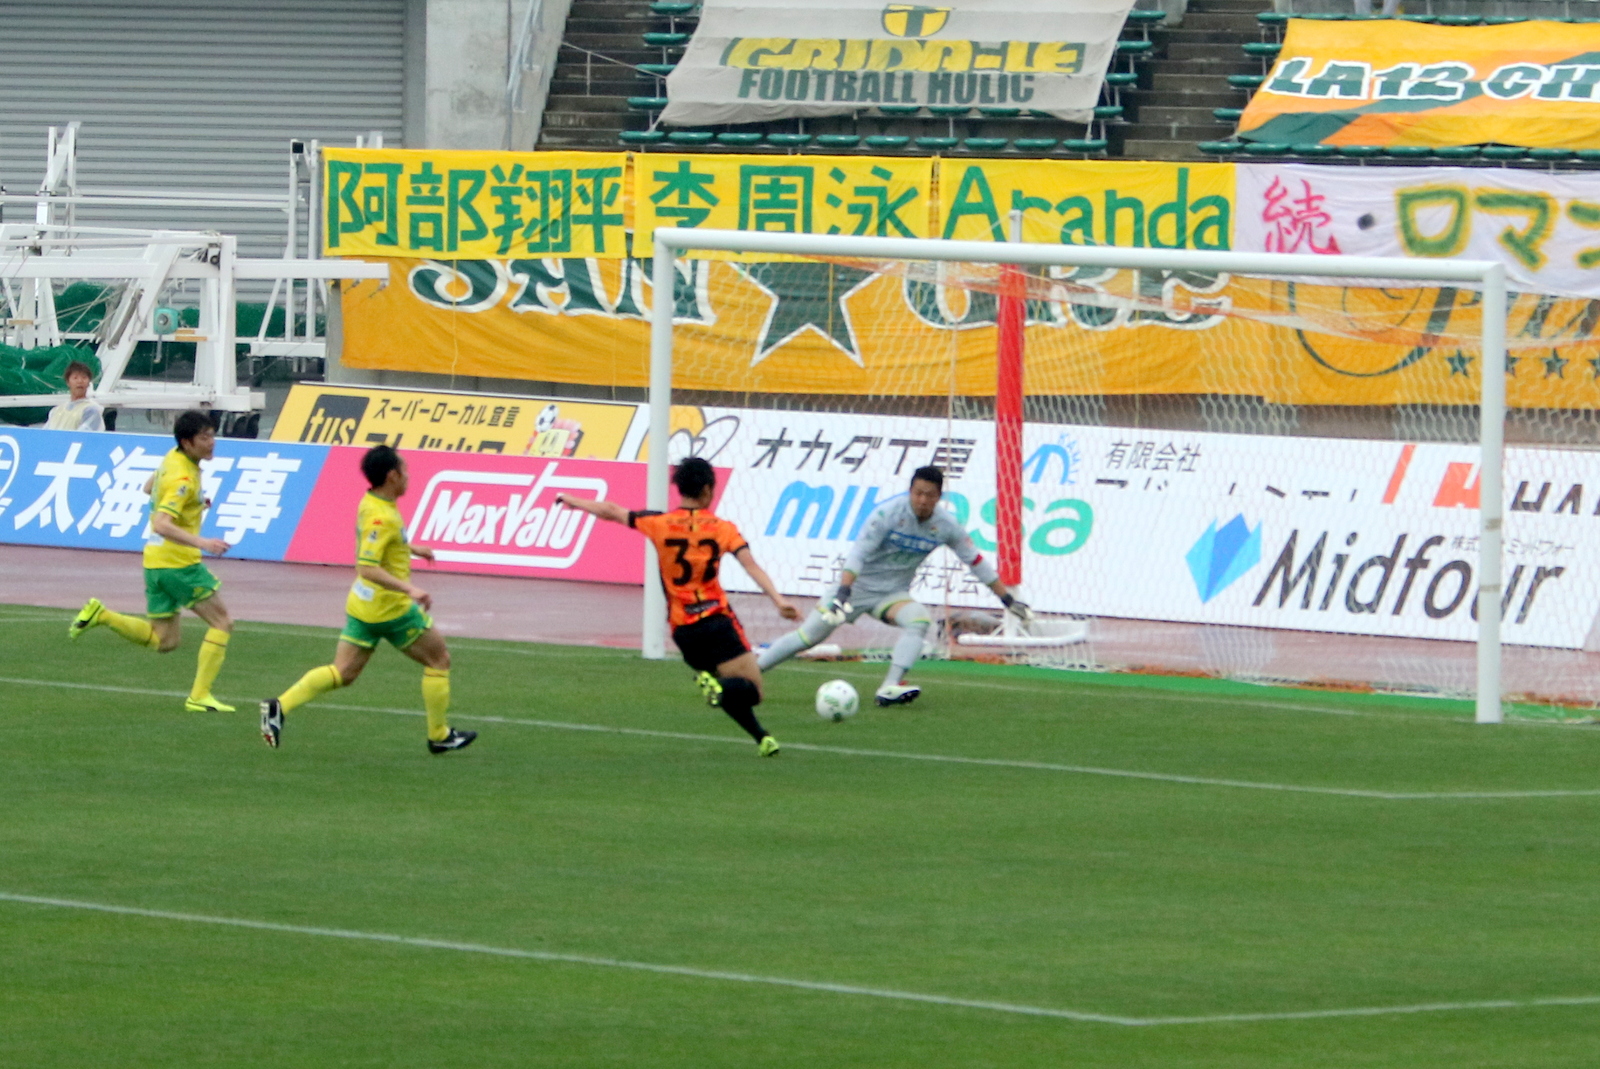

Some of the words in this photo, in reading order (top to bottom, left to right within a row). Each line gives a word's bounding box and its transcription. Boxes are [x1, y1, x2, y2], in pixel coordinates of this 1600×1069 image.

[738, 68, 917, 103] FOOTBALL
[927, 72, 1034, 104] HOLIC
[328, 160, 624, 254] 阿部翔平
[649, 161, 920, 248] 李周泳
[942, 165, 1230, 250] Aranda
[373, 398, 521, 428] スーパーローカル宣言
[1105, 437, 1202, 473] 有限会社
[420, 466, 584, 550] MaxValu
[665, 538, 720, 586] 32
